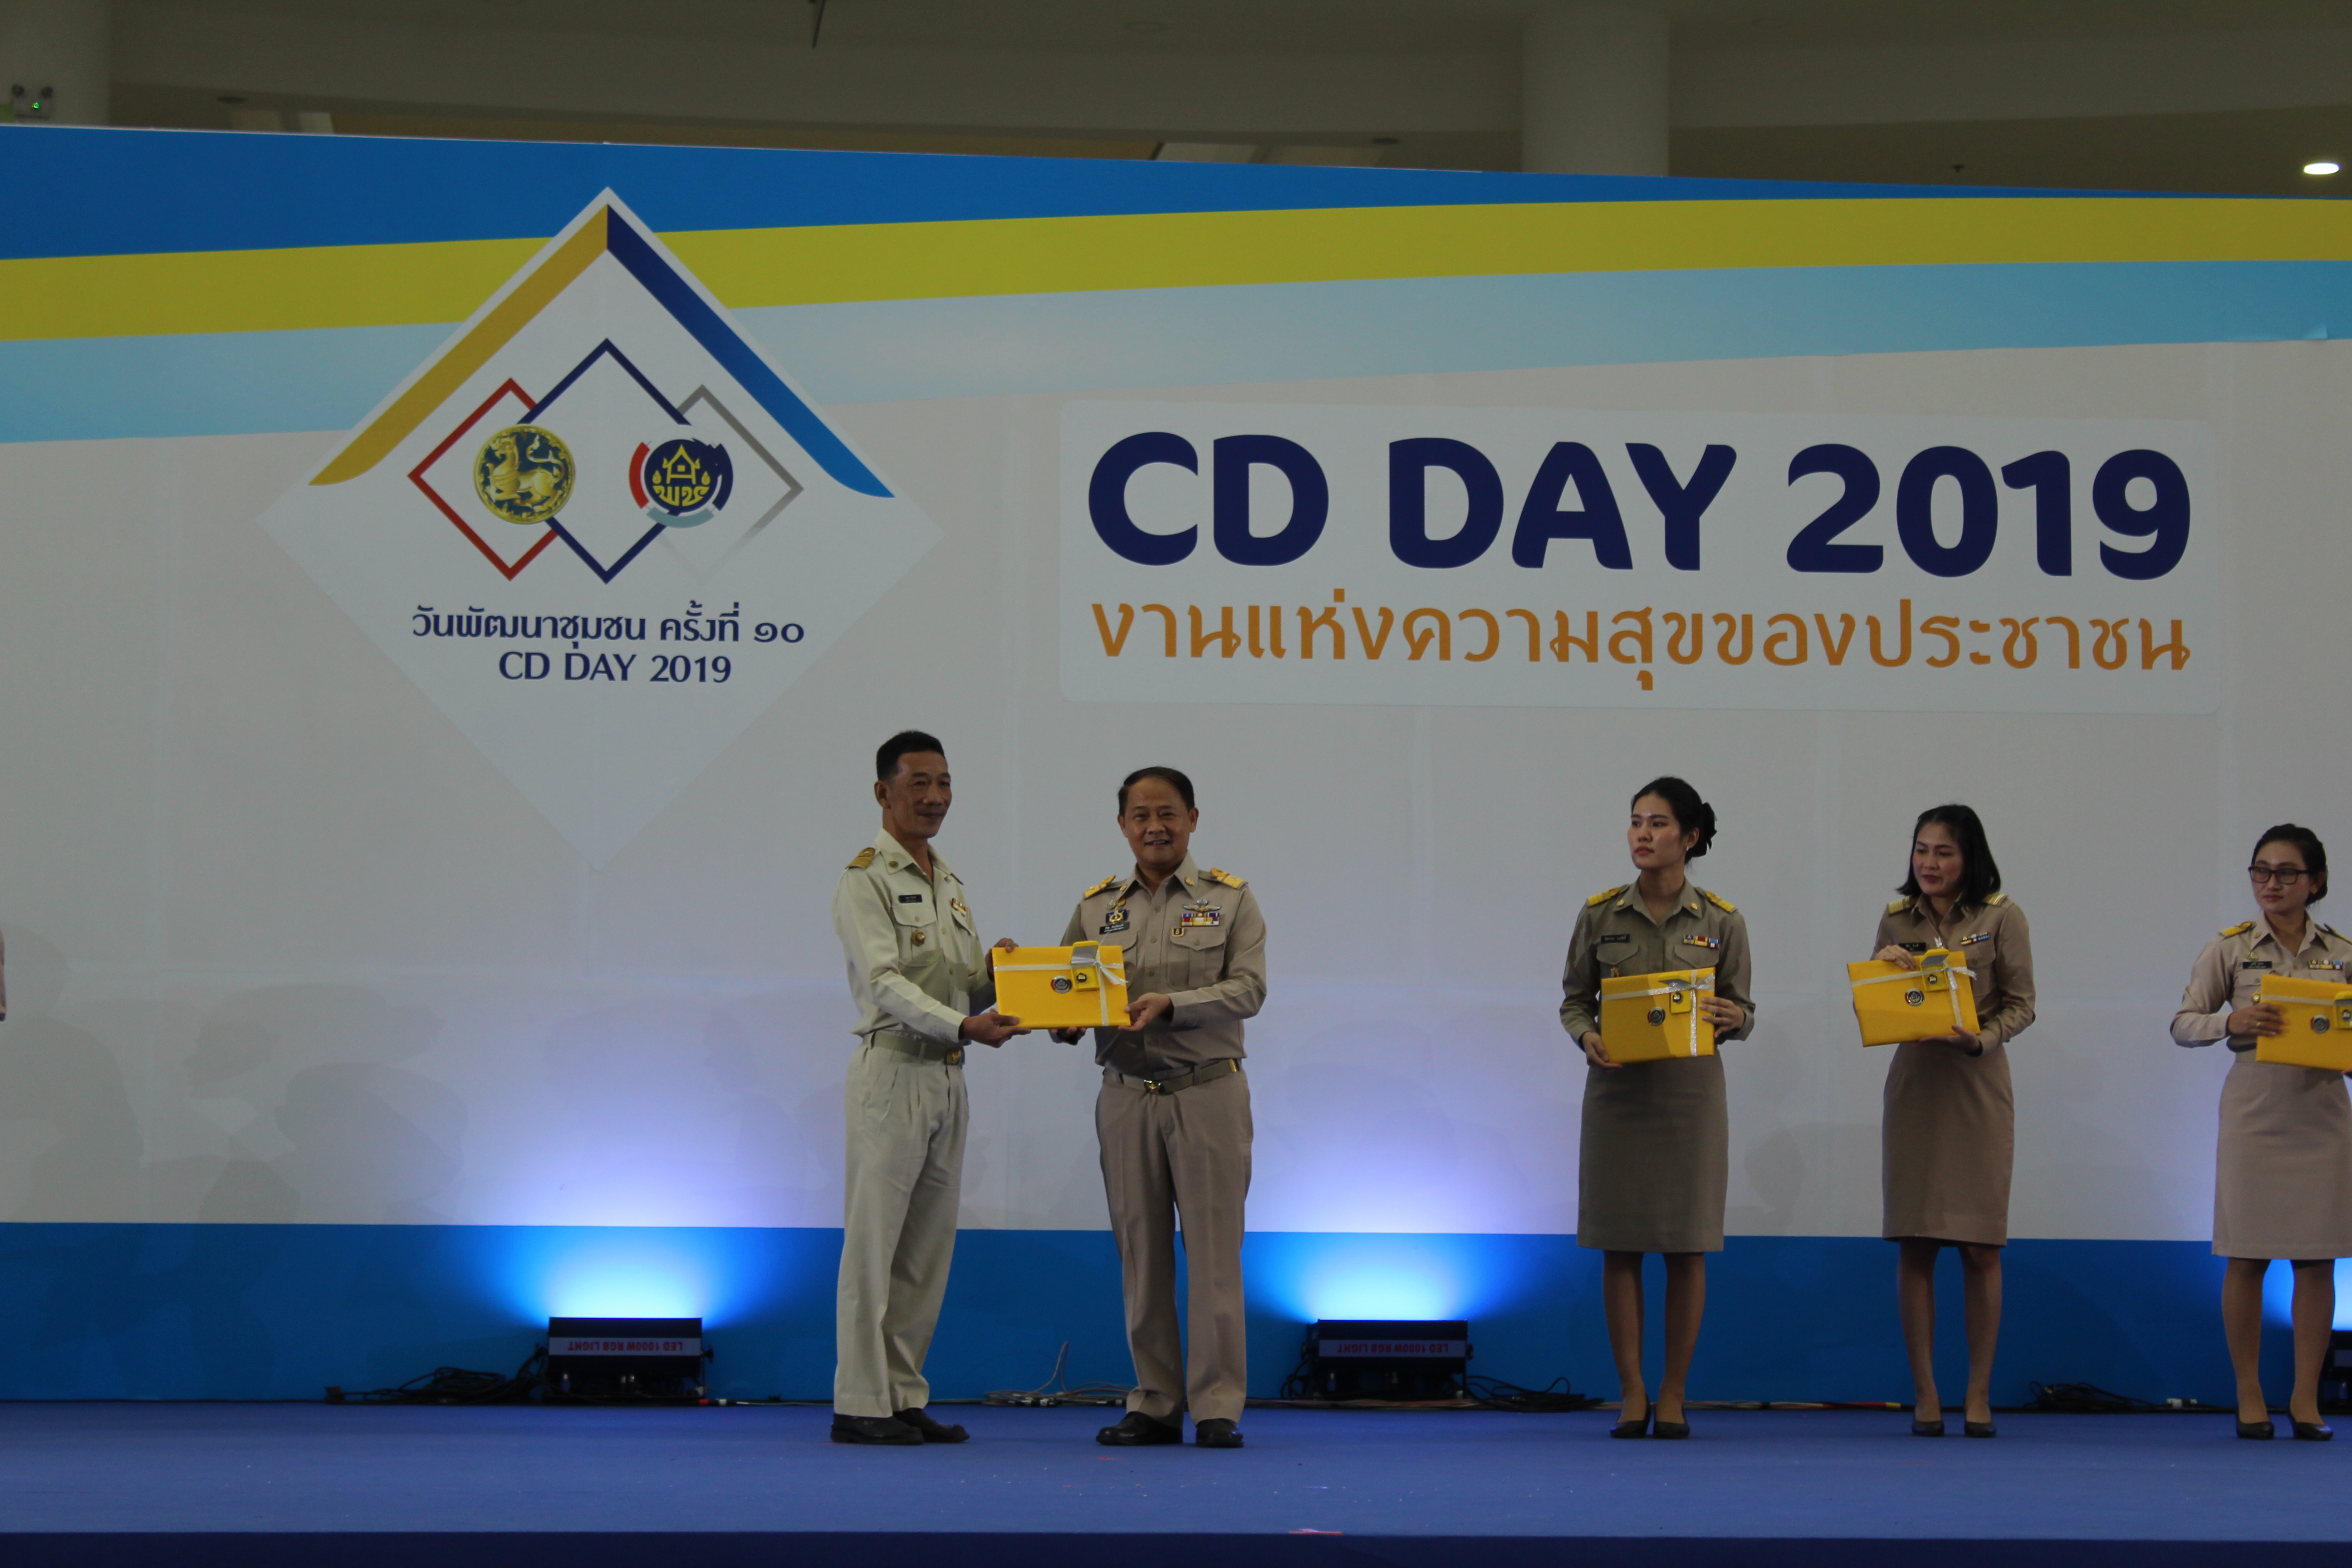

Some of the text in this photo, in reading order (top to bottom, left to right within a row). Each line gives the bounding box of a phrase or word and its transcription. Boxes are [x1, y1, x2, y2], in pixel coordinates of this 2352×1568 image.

[1089, 431, 2190, 580] CD DAY 2019
[412, 600, 804, 649] วันพัฒนาชุมชน ครั้งที่ ๑๐
[1092, 588, 2191, 691] งานแห่งความสุขของประชาชน
[499, 651, 731, 683] CD DAY 2019
[568, 1342, 683, 1351] LED 1000W RGB LIGHT
[1337, 1343, 1368, 1353] LIGHT
[1371, 1343, 1392, 1353] RGB
[1430, 1343, 1449, 1353] LED
